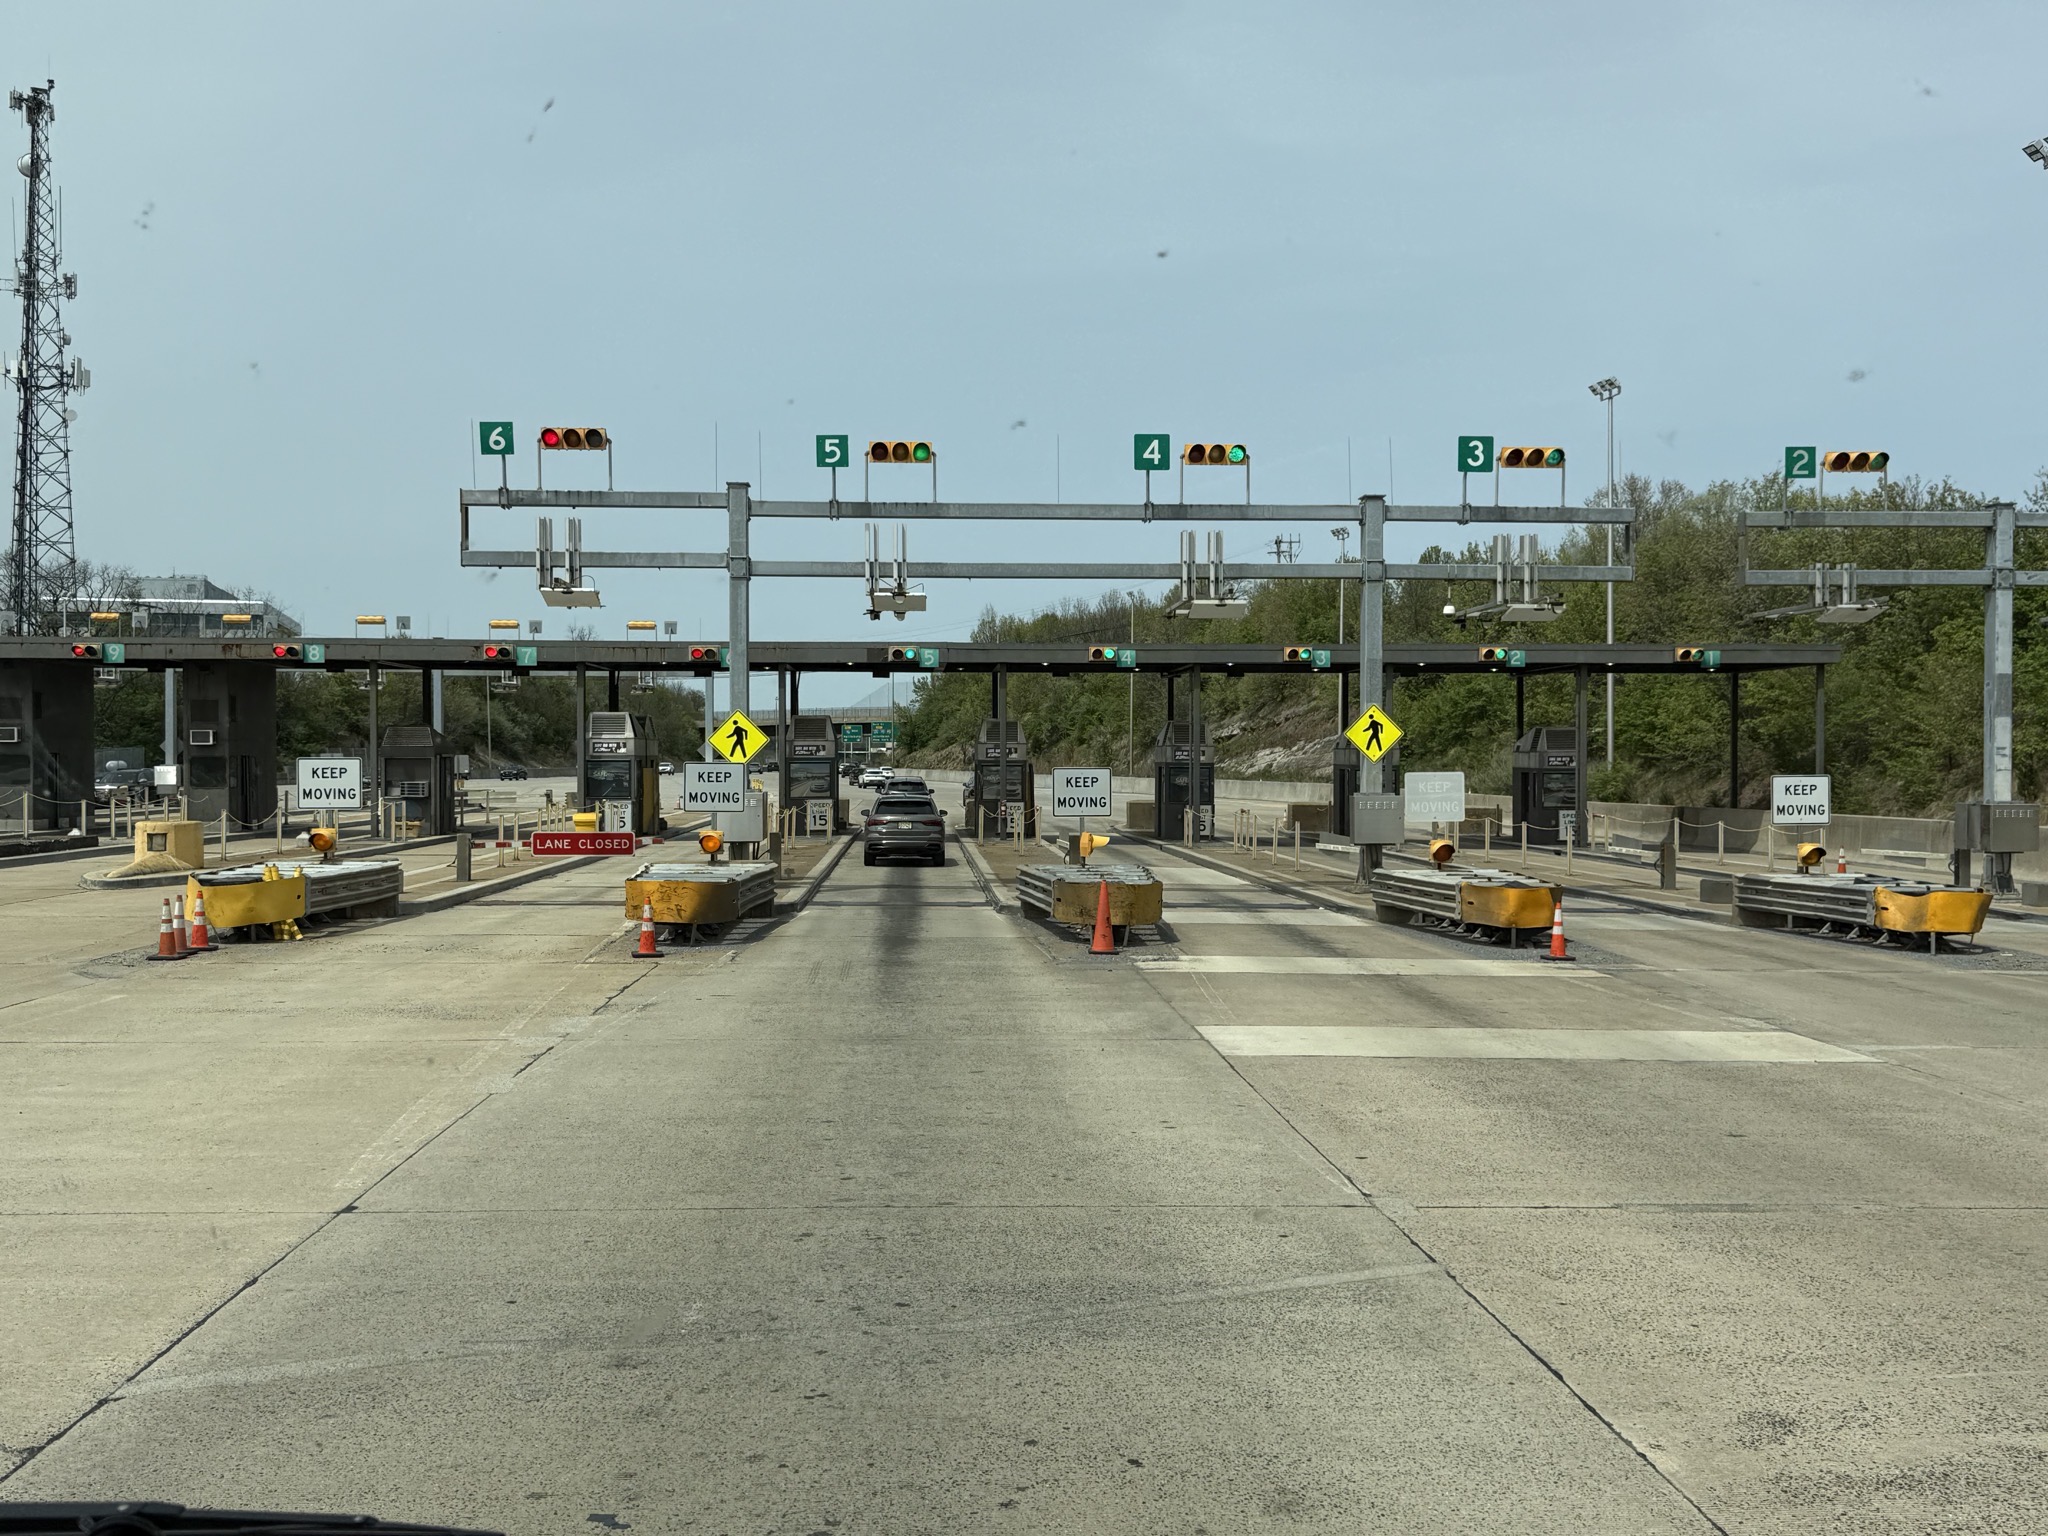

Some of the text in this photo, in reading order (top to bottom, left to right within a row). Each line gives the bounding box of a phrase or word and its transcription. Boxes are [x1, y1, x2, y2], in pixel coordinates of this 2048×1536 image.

[489, 426, 506, 450] 6
[824, 439, 841, 463] 5
[1142, 439, 1161, 465] 4
[1467, 440, 1484, 467] 3
[1792, 449, 1809, 475] 2
[108, 645, 119, 660] 9
[309, 645, 319, 660] 8
[521, 648, 532, 664] 7
[924, 650, 934, 665] 5
[1121, 650, 1131, 665] 4
[1316, 650, 1326, 665] 3
[1510, 650, 1520, 665] 2
[1709, 651, 1713, 665] 1
[312, 767, 348, 779] KEEP
[698, 772, 732, 783] KEEP
[1066, 776, 1099, 788] KEEP
[1419, 782, 1451, 793] KEEP
[303, 788, 356, 800] MOVING
[1784, 784, 1817, 796] KEEP
[689, 792, 740, 803] MOVING
[1057, 796, 1107, 808] MOVING
[1411, 801, 1459, 813] MOVING
[1776, 804, 1825, 816] MOVING
[812, 814, 828, 826] 15
[536, 839, 630, 849] LANE CLOSED
